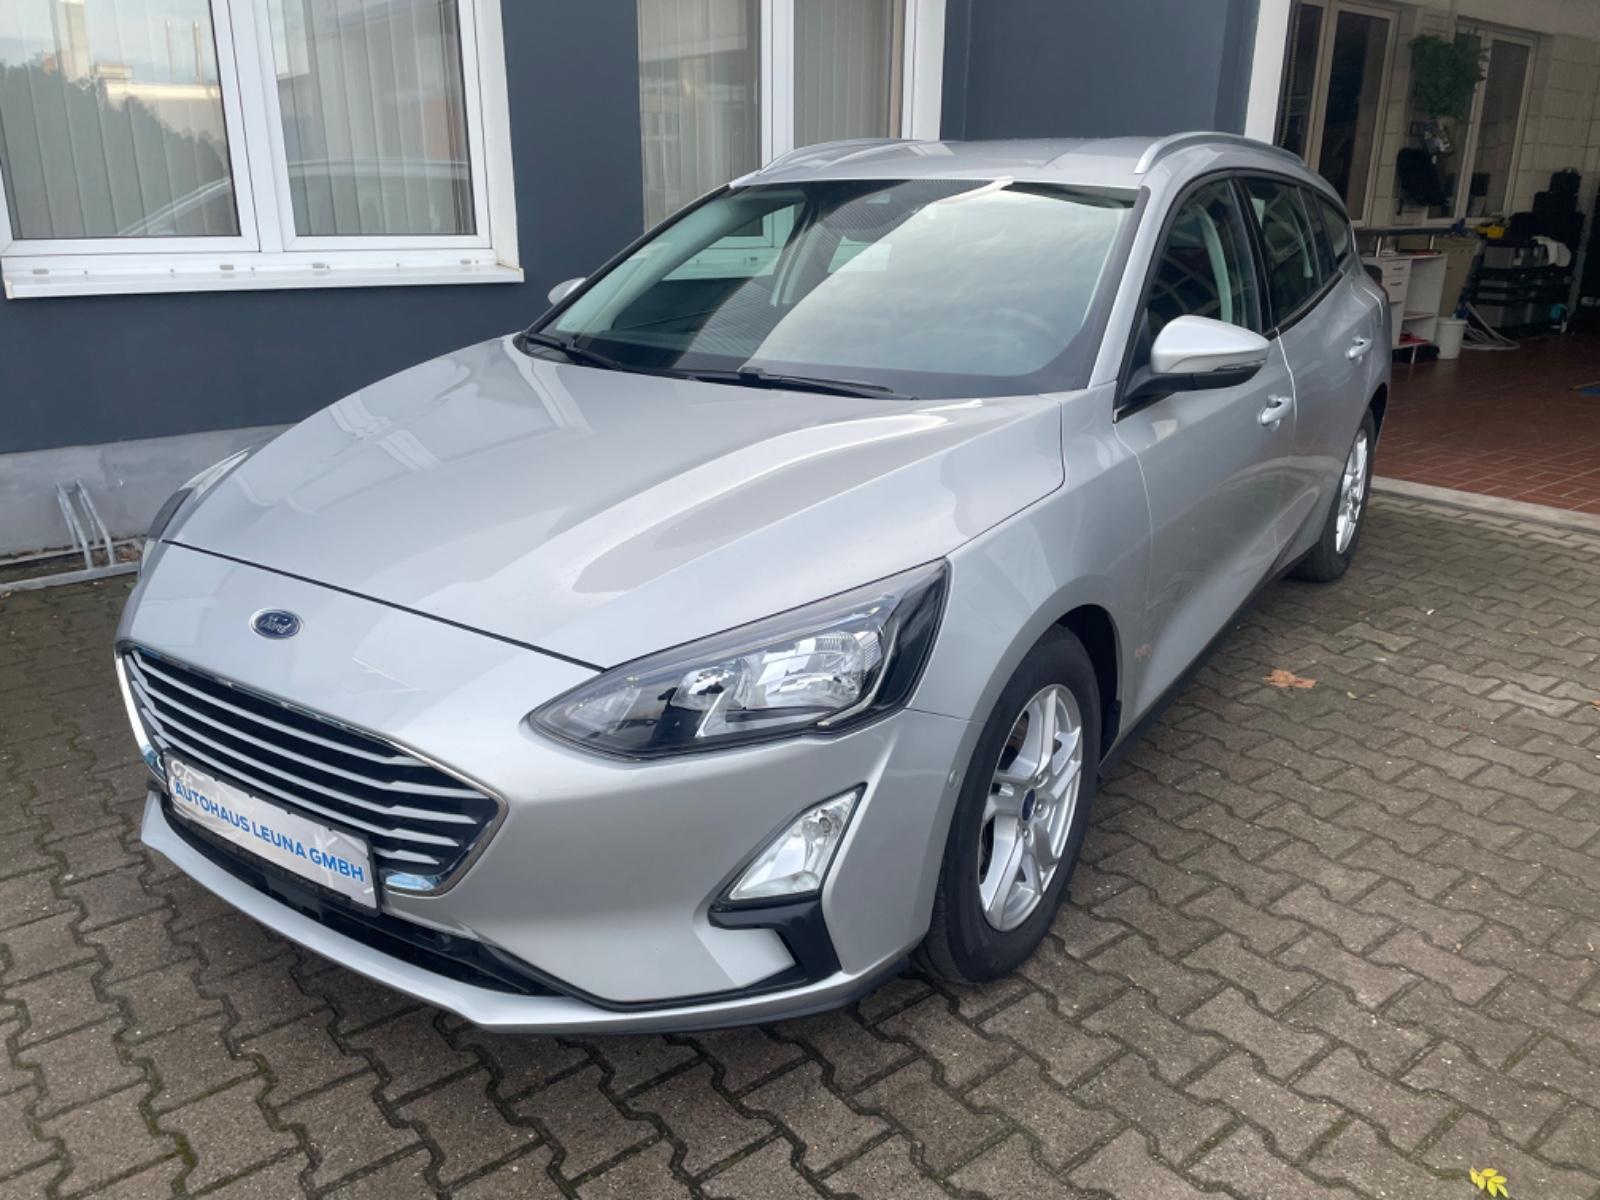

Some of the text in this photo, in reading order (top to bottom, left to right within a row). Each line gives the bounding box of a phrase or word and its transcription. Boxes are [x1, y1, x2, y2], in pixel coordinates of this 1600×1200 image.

[175, 782, 365, 882] AUTOHAUS LEUNA GMBH
